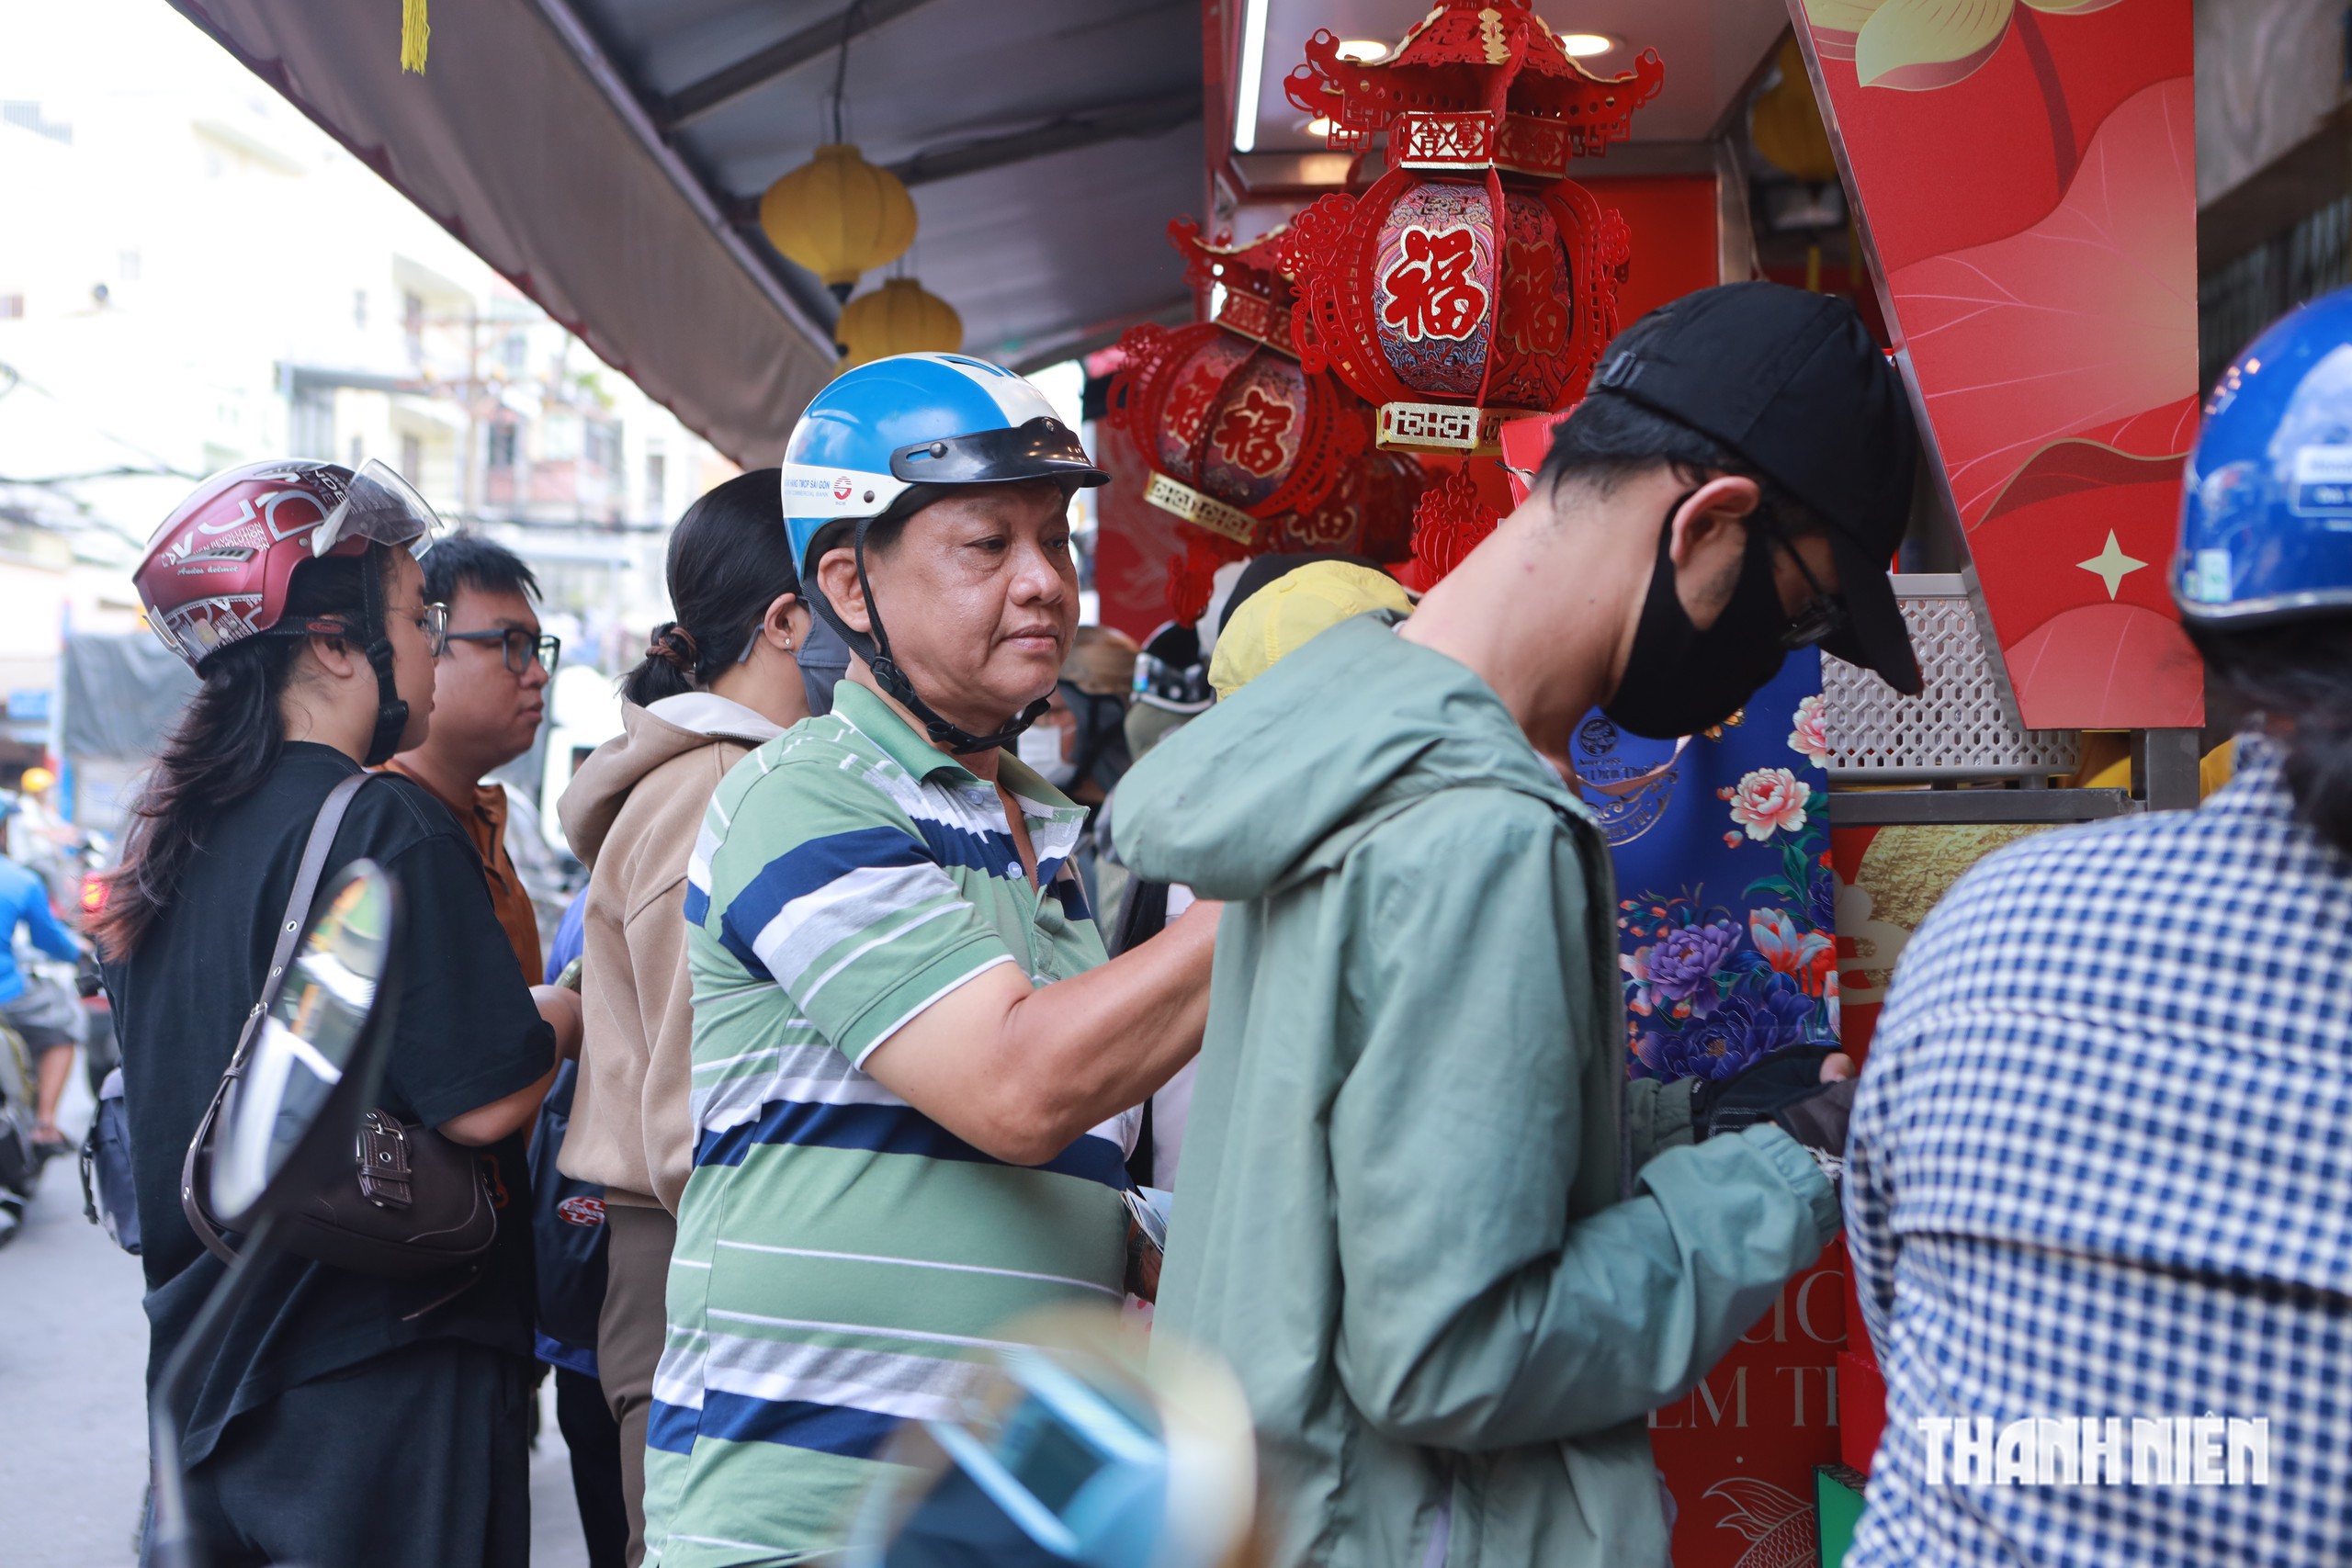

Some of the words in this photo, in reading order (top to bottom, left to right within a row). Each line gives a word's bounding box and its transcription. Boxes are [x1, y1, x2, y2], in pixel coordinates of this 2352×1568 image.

[1382, 225, 1488, 342] 福
[1213, 386, 1295, 479] 福
[819, 478, 831, 489] GÒN
[208, 565, 239, 574] helmet
